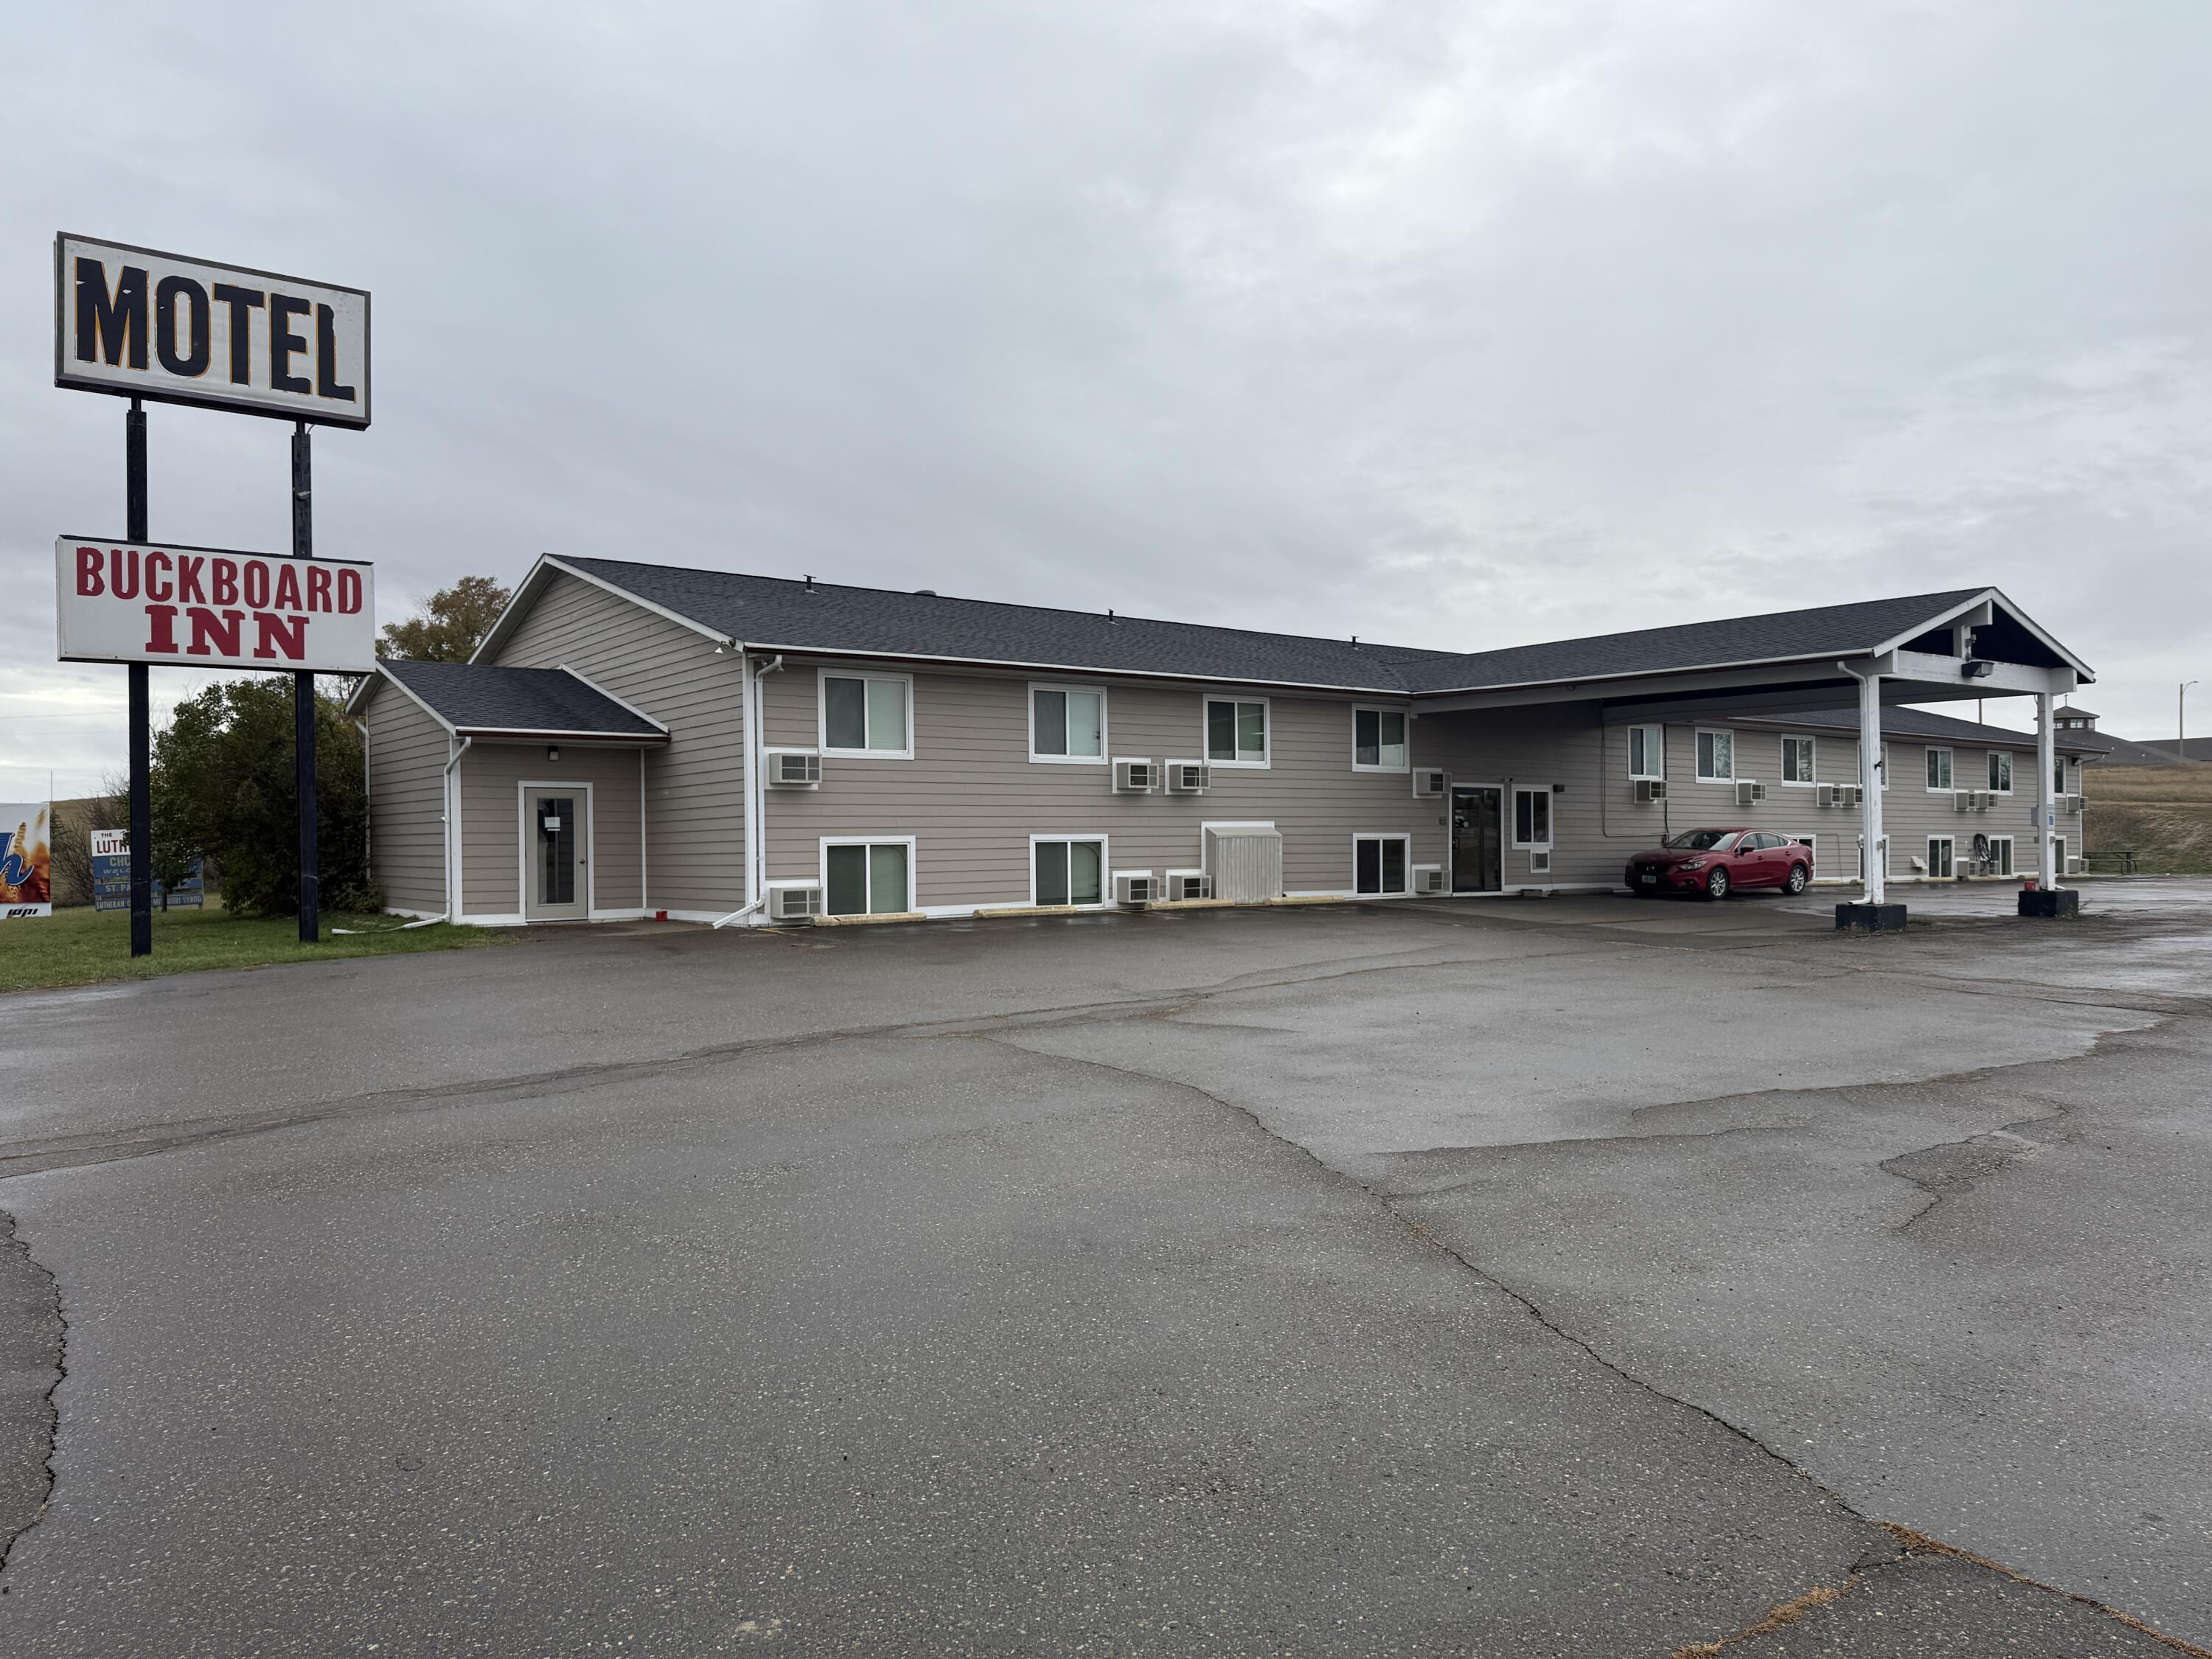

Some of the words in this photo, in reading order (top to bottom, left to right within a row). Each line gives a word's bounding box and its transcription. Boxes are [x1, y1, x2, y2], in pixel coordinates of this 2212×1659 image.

[74, 257, 356, 403] MOTEL
[76, 546, 363, 615] BUCKBOARD
[145, 604, 310, 660] INN
[97, 839, 131, 854] LUTH
[109, 857, 131, 866] CHU
[97, 900, 125, 909] LUTHERAN
[153, 896, 181, 905] MIOURI
[183, 895, 201, 904] SYNOD
